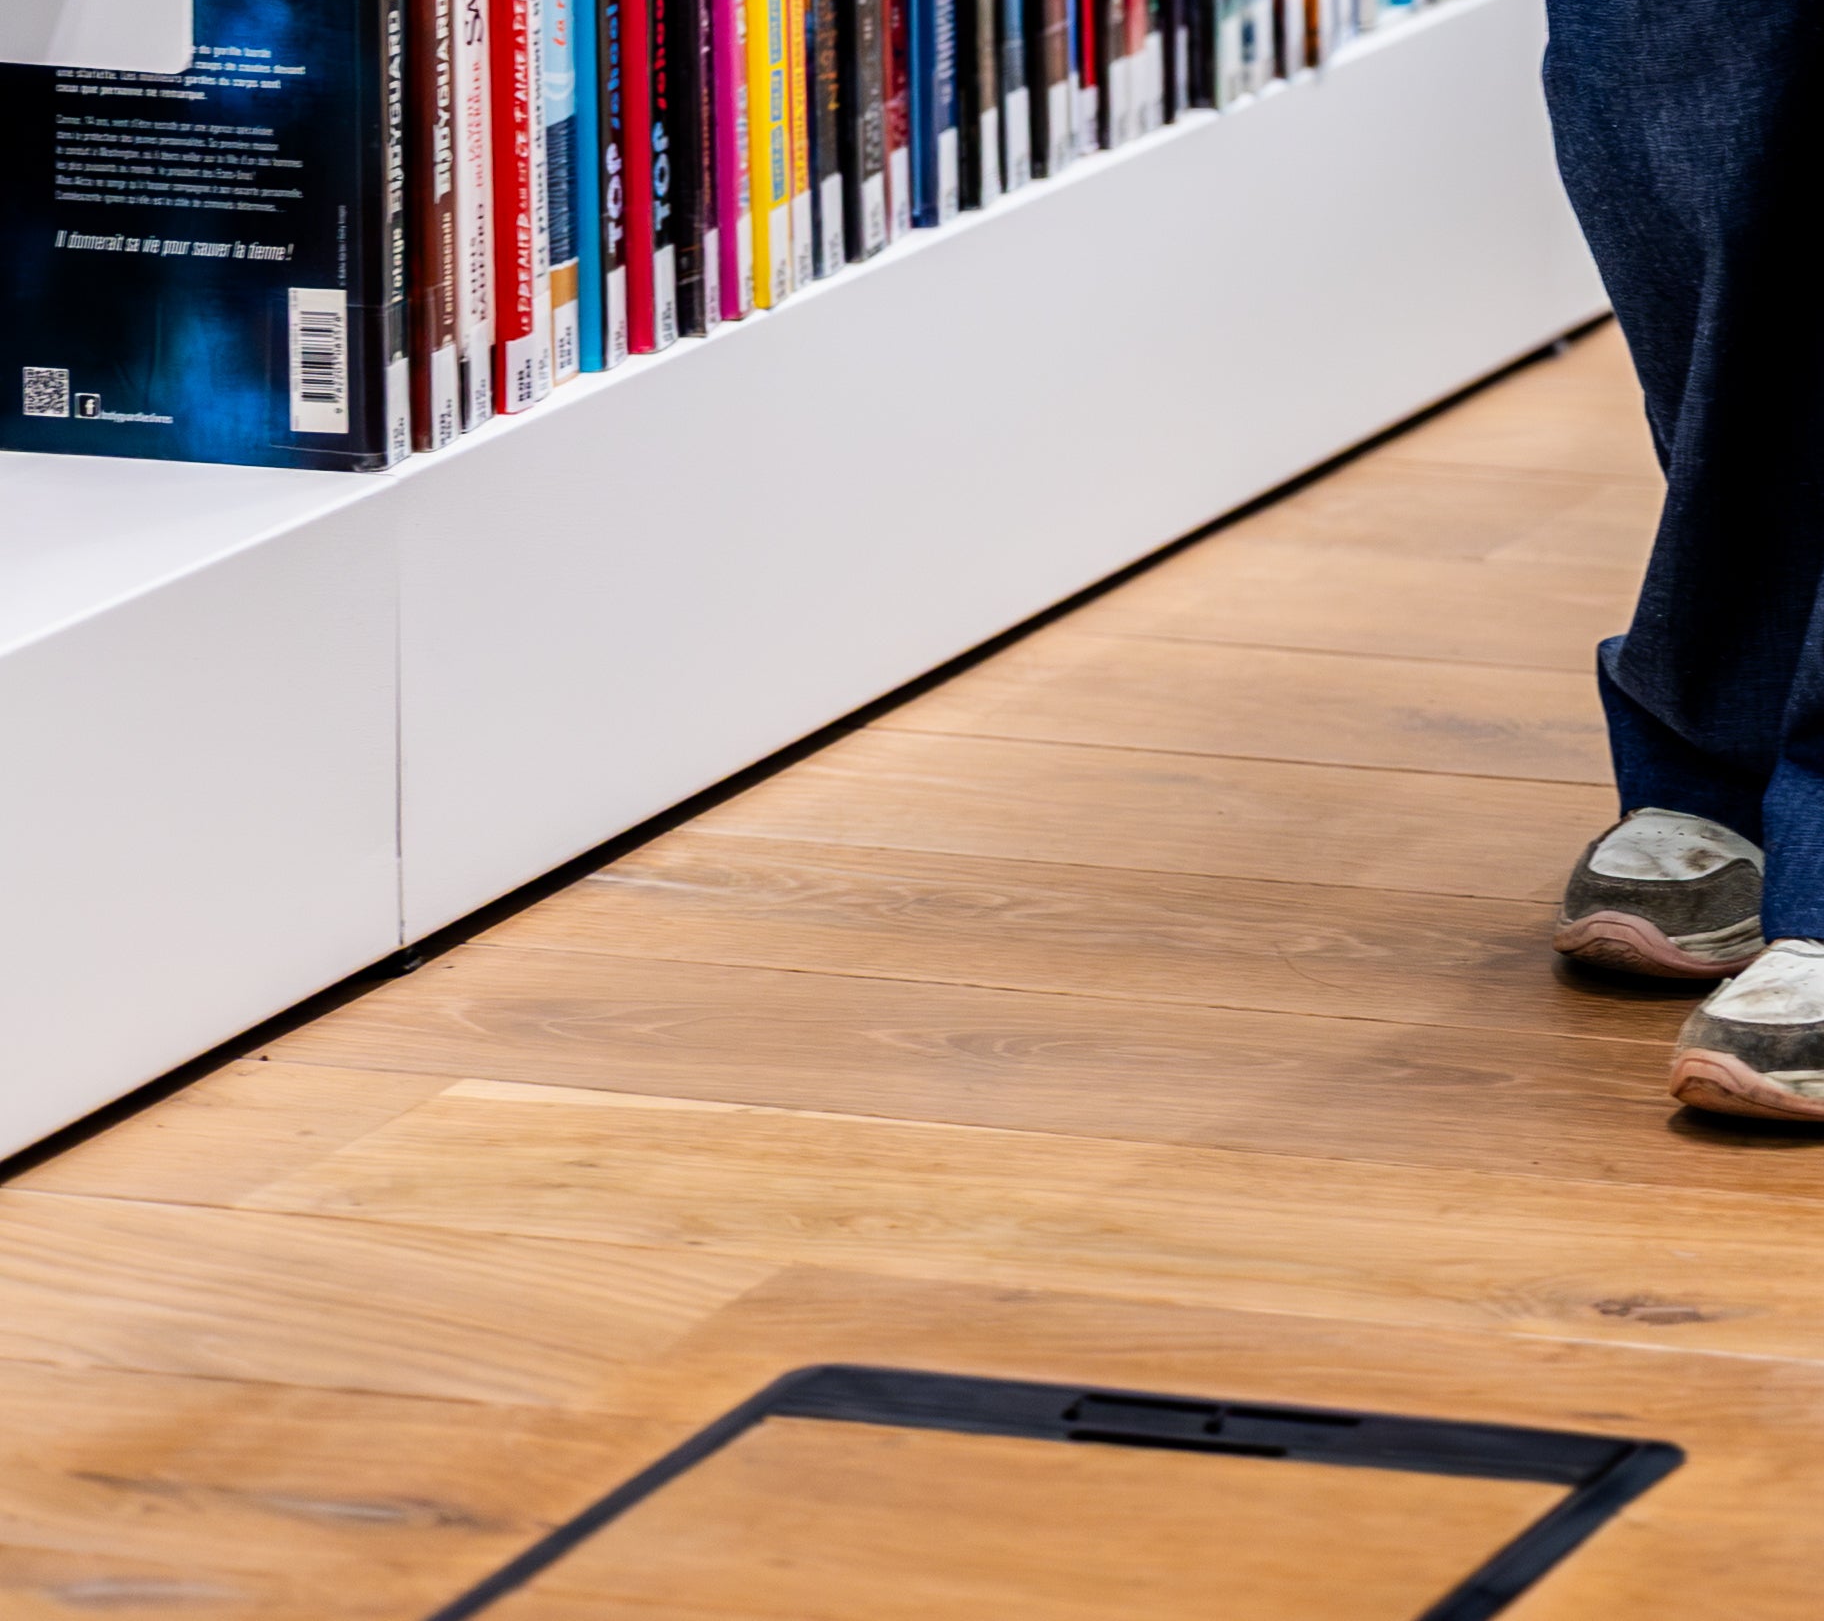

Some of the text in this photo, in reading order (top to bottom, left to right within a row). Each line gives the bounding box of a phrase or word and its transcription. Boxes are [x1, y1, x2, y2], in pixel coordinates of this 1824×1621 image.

[551, 19, 567, 46] La
[386, 9, 404, 224] BODYGUARD
[513, 49, 528, 123] T'AIME
[605, 142, 624, 254] TOP
[651, 121, 670, 231] TOP
[515, 213, 532, 313] PREMIER
